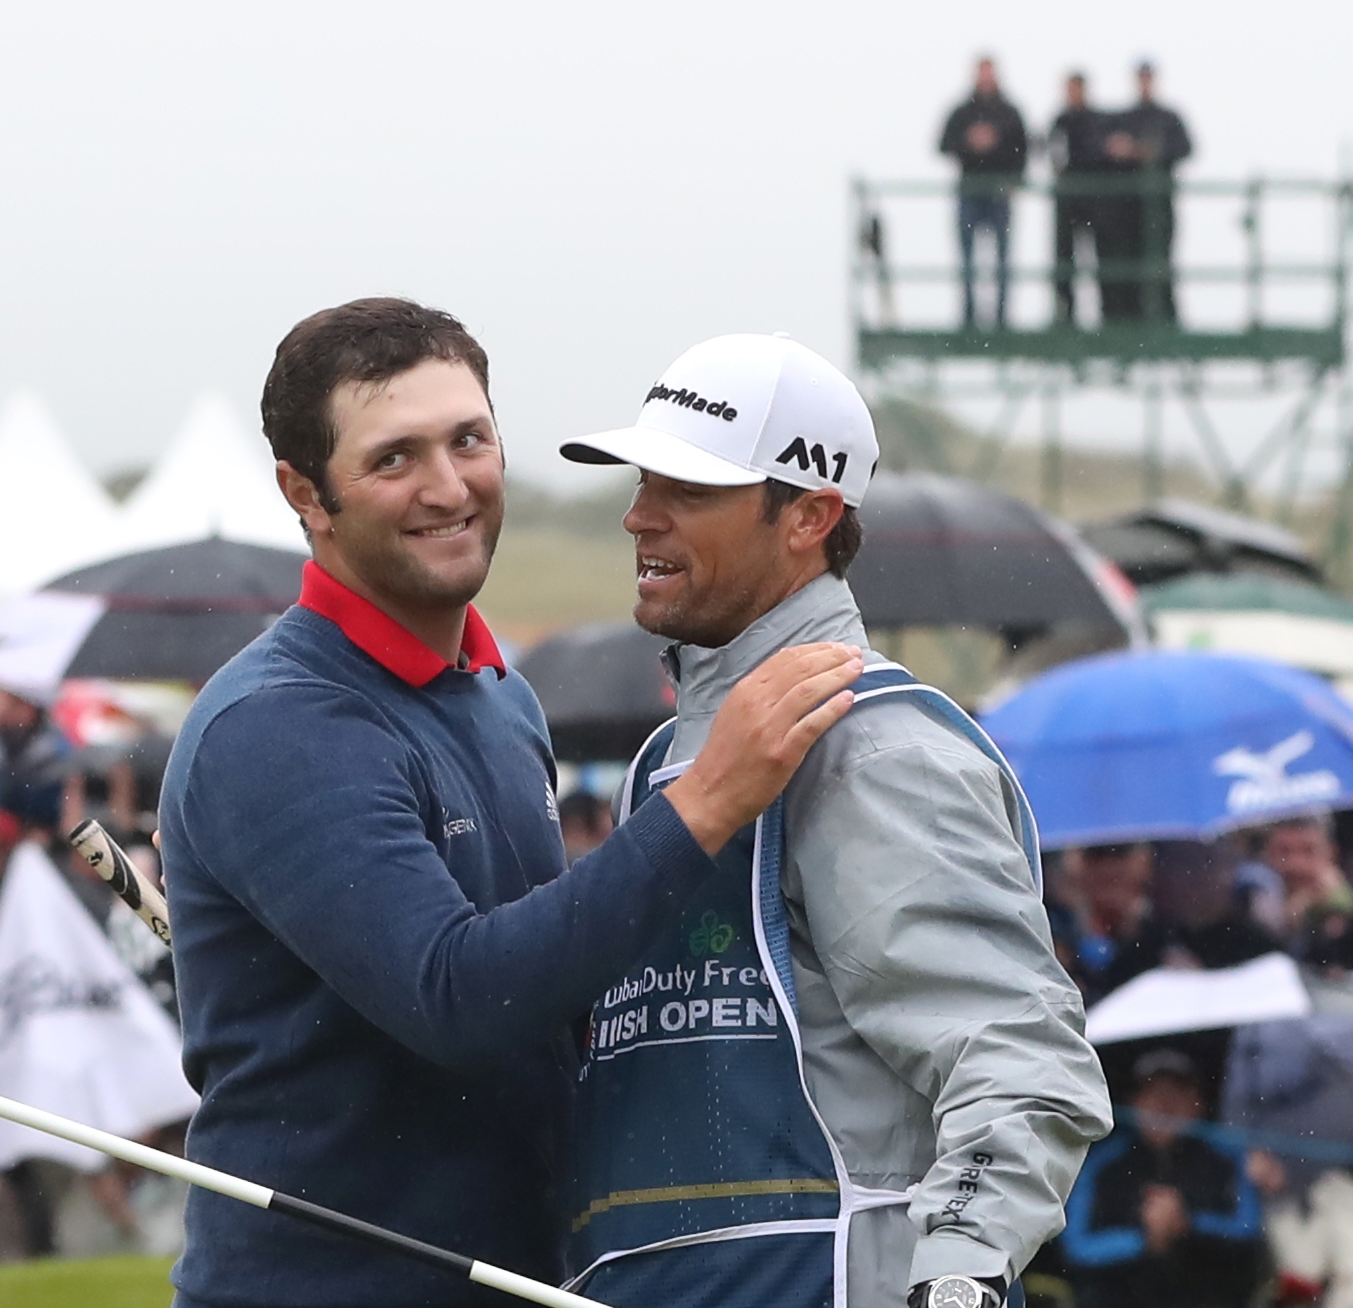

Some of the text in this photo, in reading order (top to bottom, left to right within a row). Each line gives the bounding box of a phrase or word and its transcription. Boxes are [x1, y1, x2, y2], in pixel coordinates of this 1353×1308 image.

[775, 436, 848, 484] M1
[643, 966, 696, 995] Duty
[659, 998, 778, 1031] OPEN
